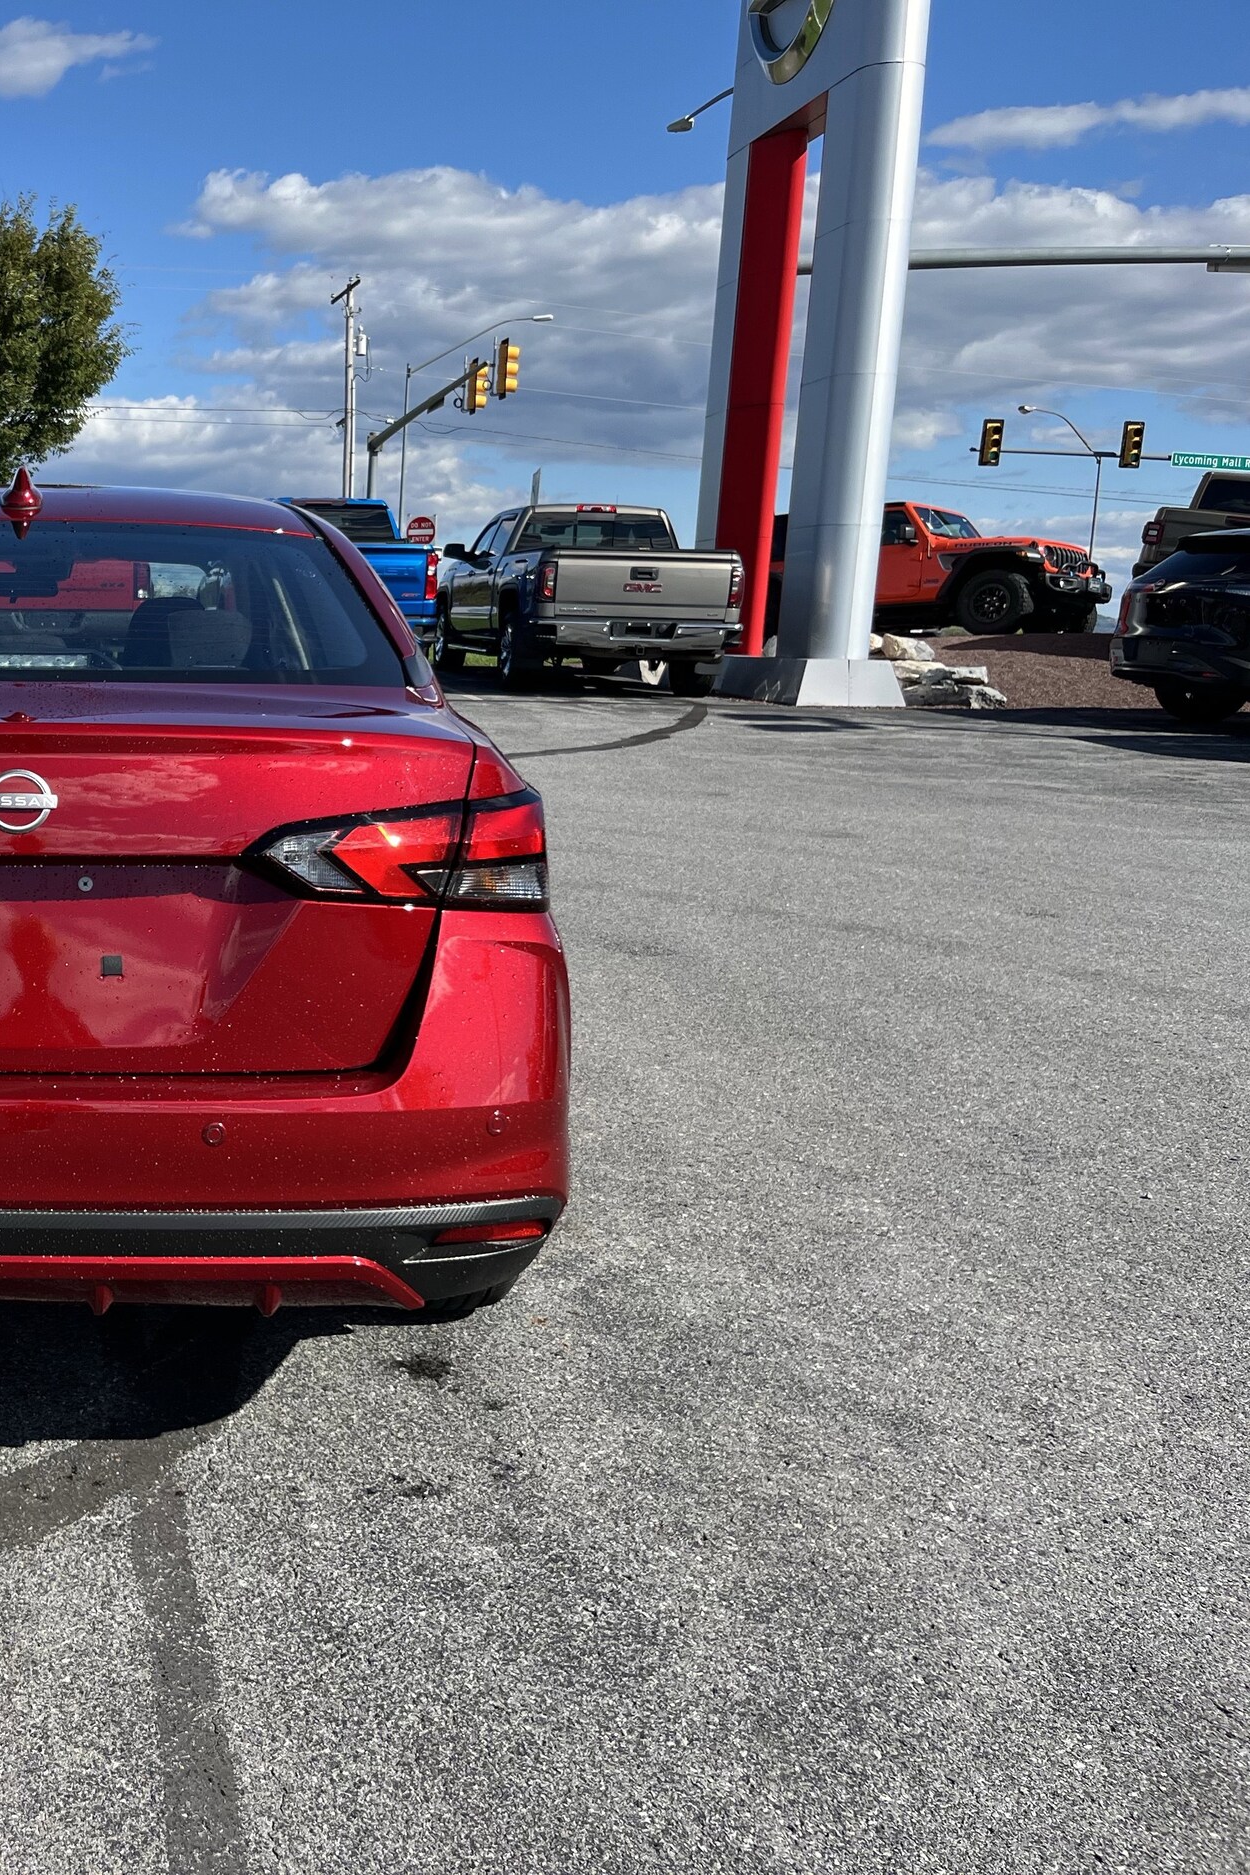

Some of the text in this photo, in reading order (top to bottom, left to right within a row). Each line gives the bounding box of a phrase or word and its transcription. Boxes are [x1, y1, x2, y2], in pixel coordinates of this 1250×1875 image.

[1174, 454, 1218, 468] Lycoming
[1221, 457, 1241, 467] Mall
[622, 582, 664, 594] GMC
